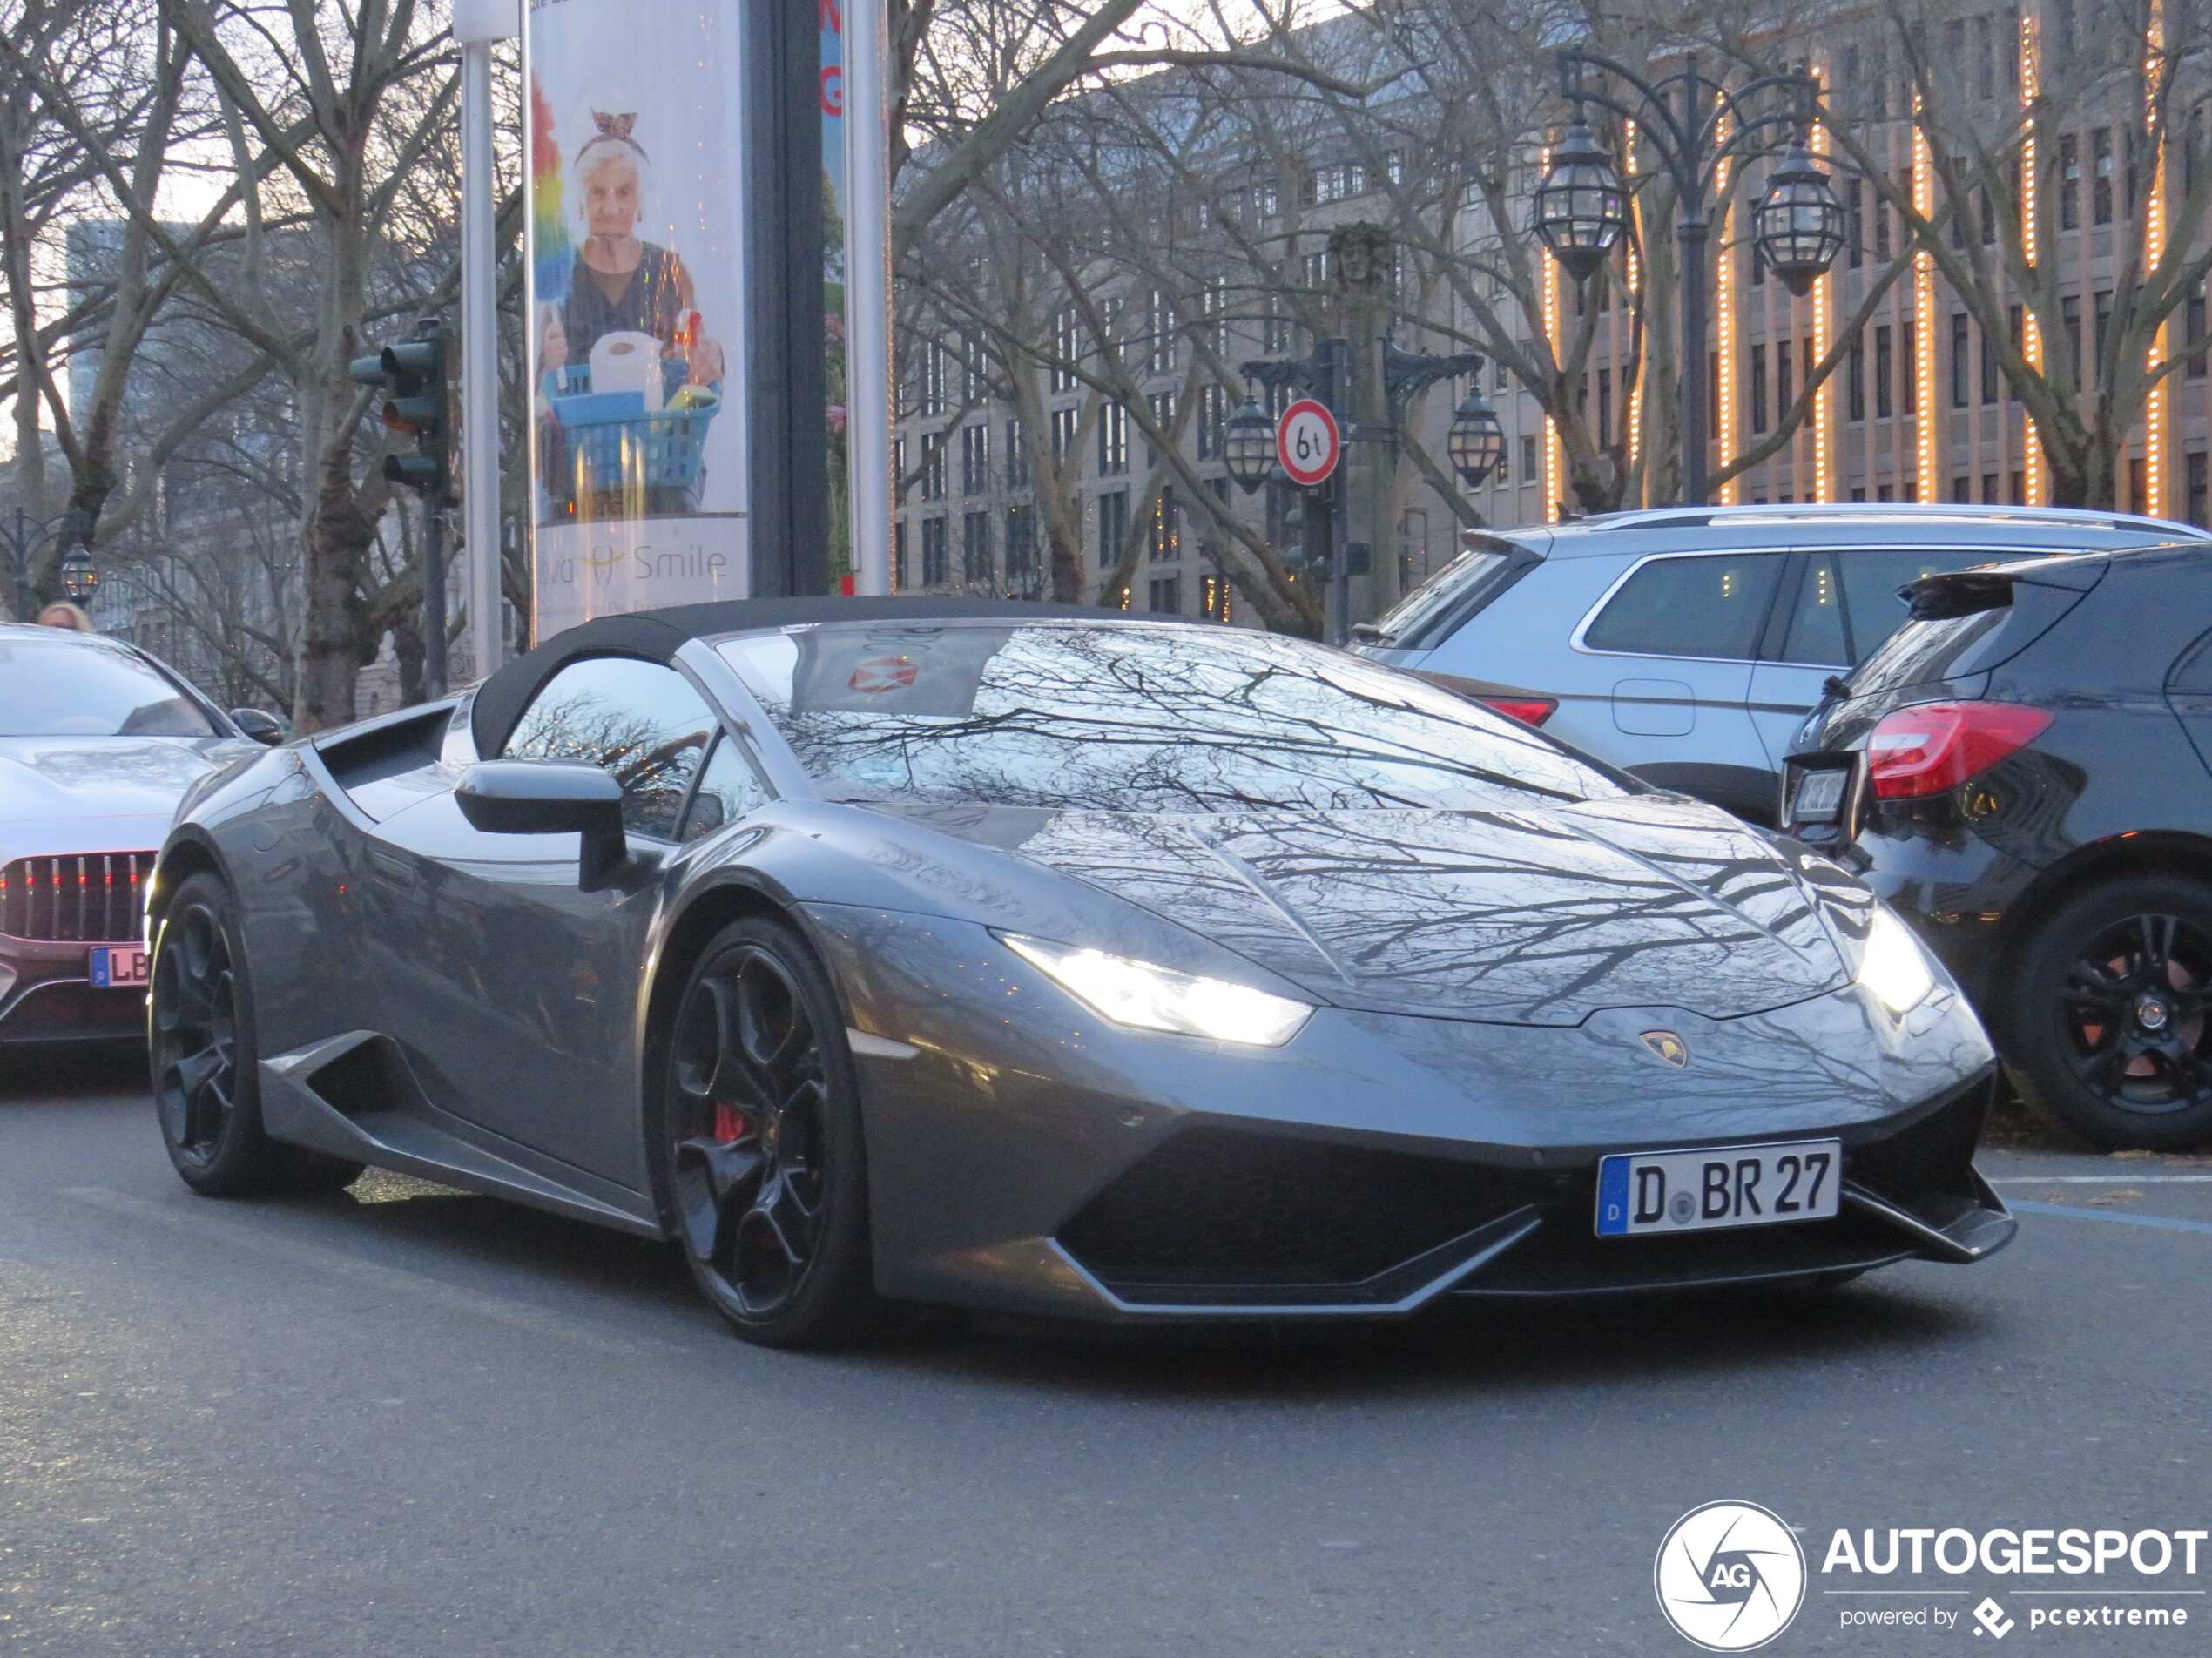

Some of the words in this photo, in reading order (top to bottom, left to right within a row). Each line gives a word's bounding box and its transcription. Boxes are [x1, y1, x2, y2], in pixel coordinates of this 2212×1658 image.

[634, 544, 726, 580] Smile
[1634, 1165, 1666, 1224] D
[1702, 1158, 1762, 1219] BR
[1774, 1152, 1831, 1214] 27
[1607, 1203, 1620, 1221] D
